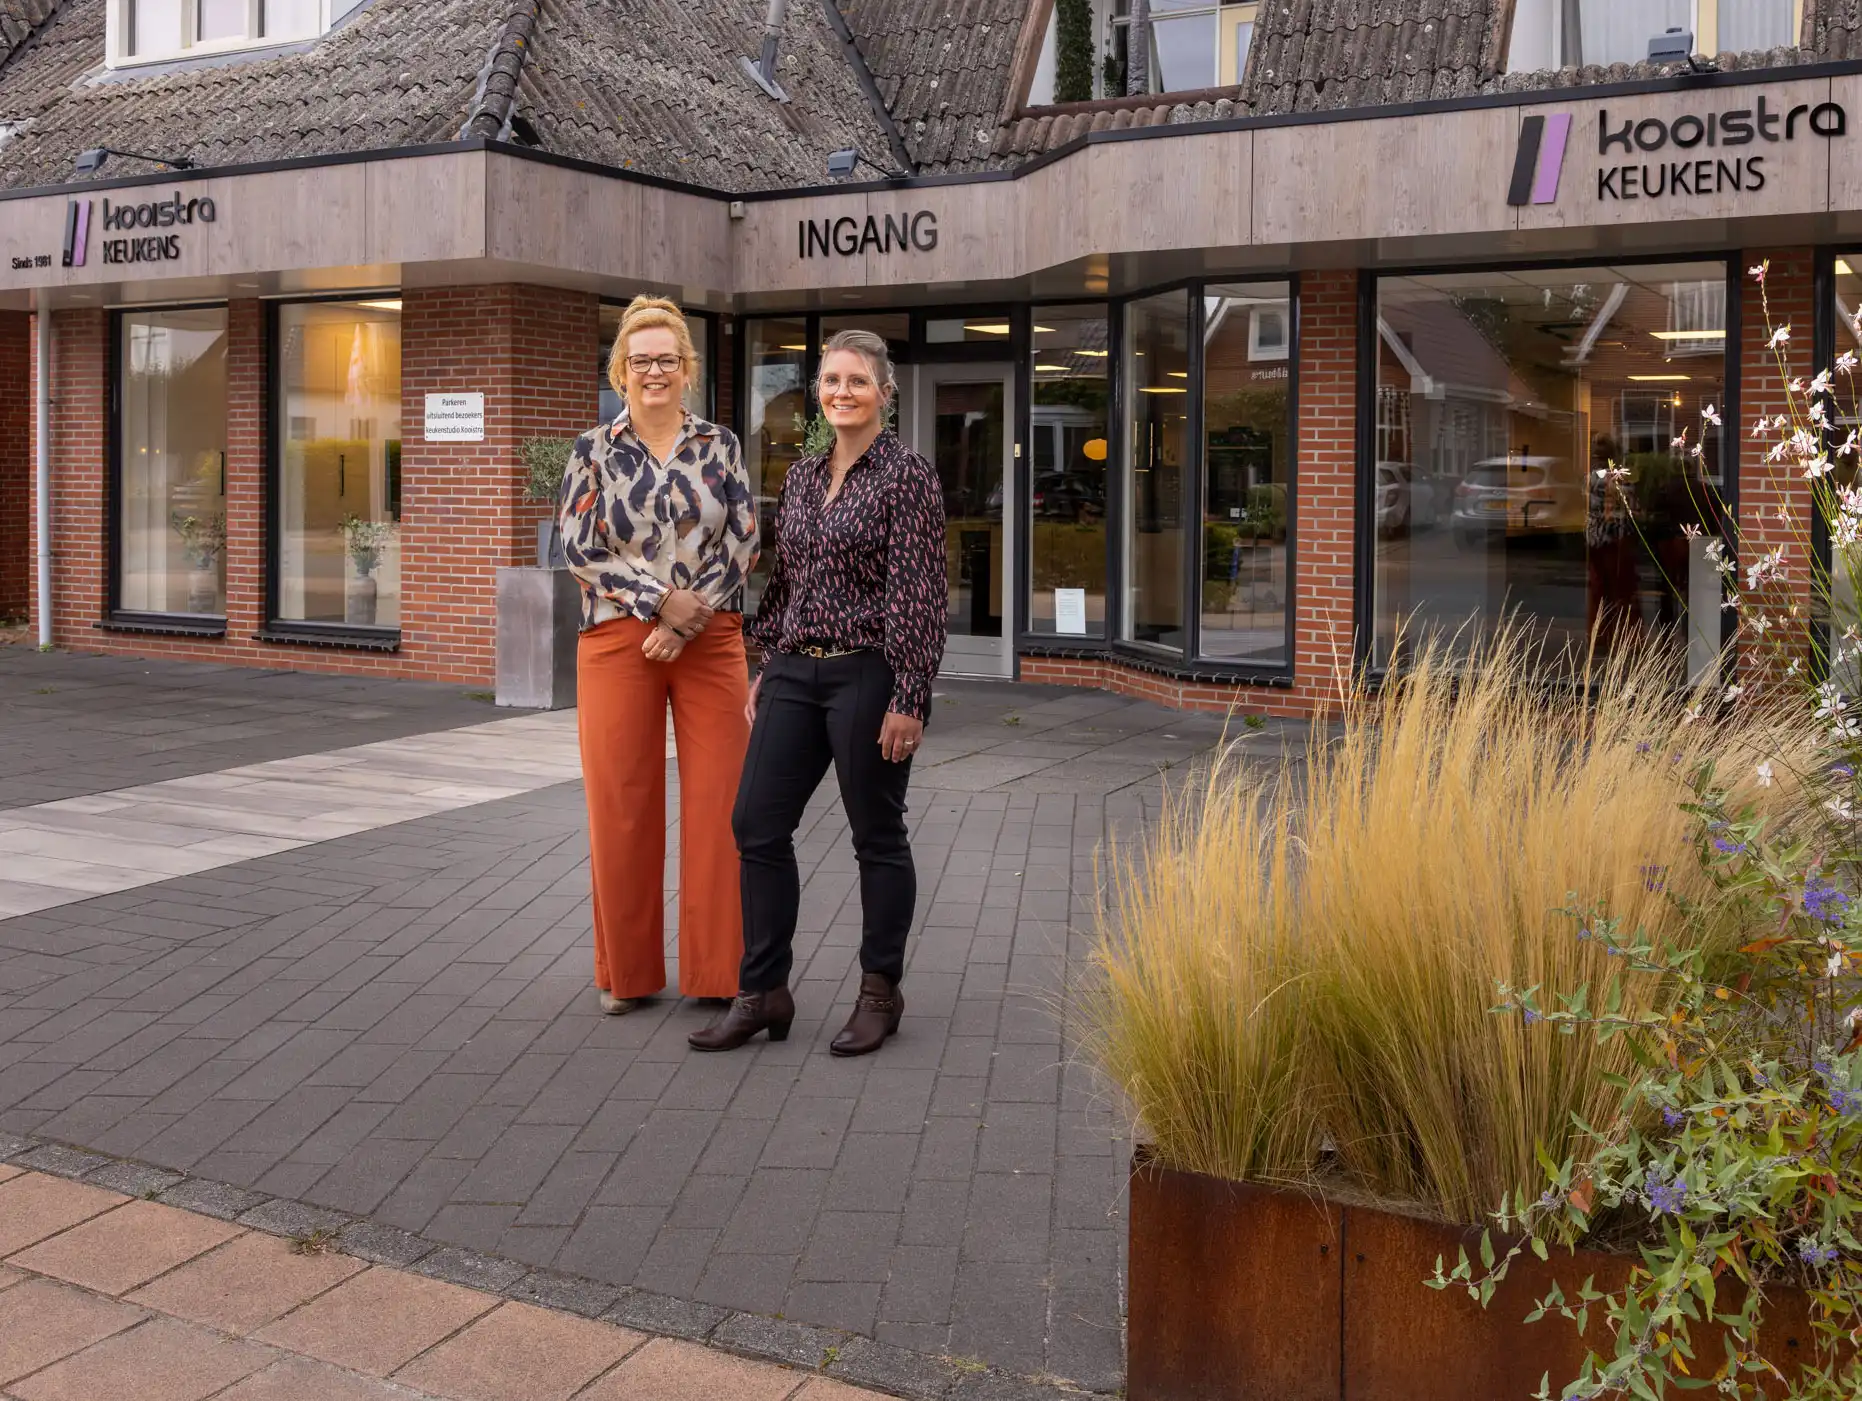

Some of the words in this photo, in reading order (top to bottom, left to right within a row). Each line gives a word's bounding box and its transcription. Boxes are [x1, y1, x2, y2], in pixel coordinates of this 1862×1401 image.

[1600, 96, 1846, 155] kooistra
[1598, 156, 1766, 201] KEUKENS
[103, 191, 215, 231] kooistra
[798, 210, 938, 259] INGANG
[12, 257, 32, 270] Sinds
[34, 254, 52, 268] 1981
[103, 235, 181, 264] KEUKENS
[427, 412, 455, 420] uitsluitend
[455, 411, 482, 419] bezoekers
[442, 398, 467, 406] Parkeren
[426, 426, 460, 434] keukenstudio
[461, 426, 483, 434] Kooistra
